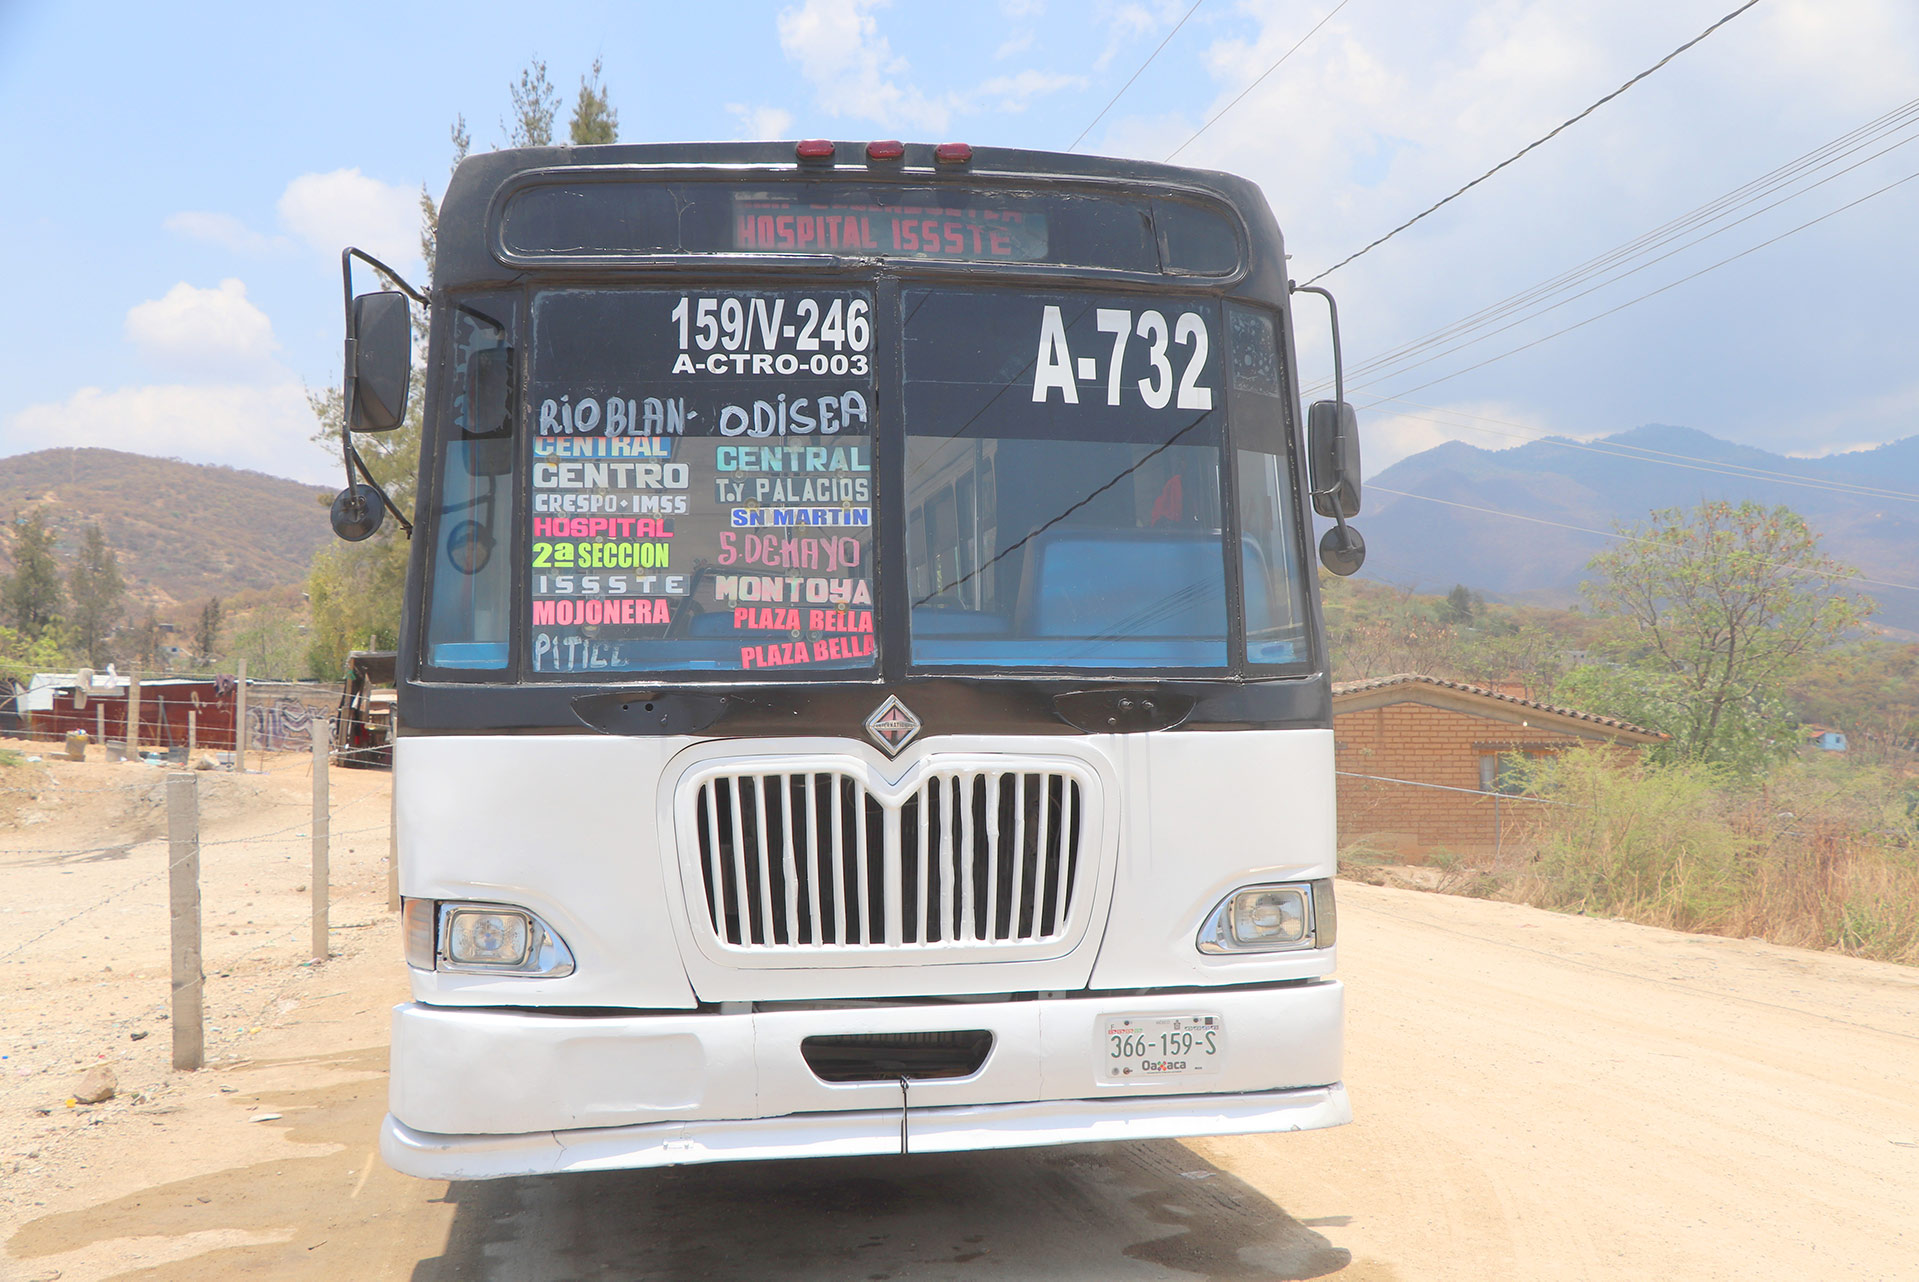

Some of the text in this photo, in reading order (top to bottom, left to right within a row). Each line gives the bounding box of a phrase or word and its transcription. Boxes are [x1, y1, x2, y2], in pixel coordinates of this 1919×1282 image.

[737, 215, 1012, 255] HOSPITAL ISSSTE
[671, 297, 870, 351] 159/V-246
[672, 354, 869, 375] A-CTRO-003
[1032, 305, 1213, 410] A-732
[534, 436, 669, 457] CENTRAL
[716, 446, 871, 472] CENTRAL
[533, 463, 690, 489] CENTRO
[756, 478, 869, 502] PALACIOS
[535, 494, 687, 514] CRESPO IMSS
[733, 509, 868, 525] SN MARTIN
[533, 517, 674, 537] HOSPITAL
[578, 543, 669, 568] SECCION
[539, 575, 684, 594] ISSSTE
[716, 576, 872, 605] MONTOYA
[533, 599, 670, 626] MOJONERA
[734, 607, 873, 633] PLAZA BELLA
[741, 634, 874, 669] PLAZA BELLA
[1111, 1031, 1216, 1058] 366-159-S
[1142, 1060, 1186, 1071] Oaxaca
